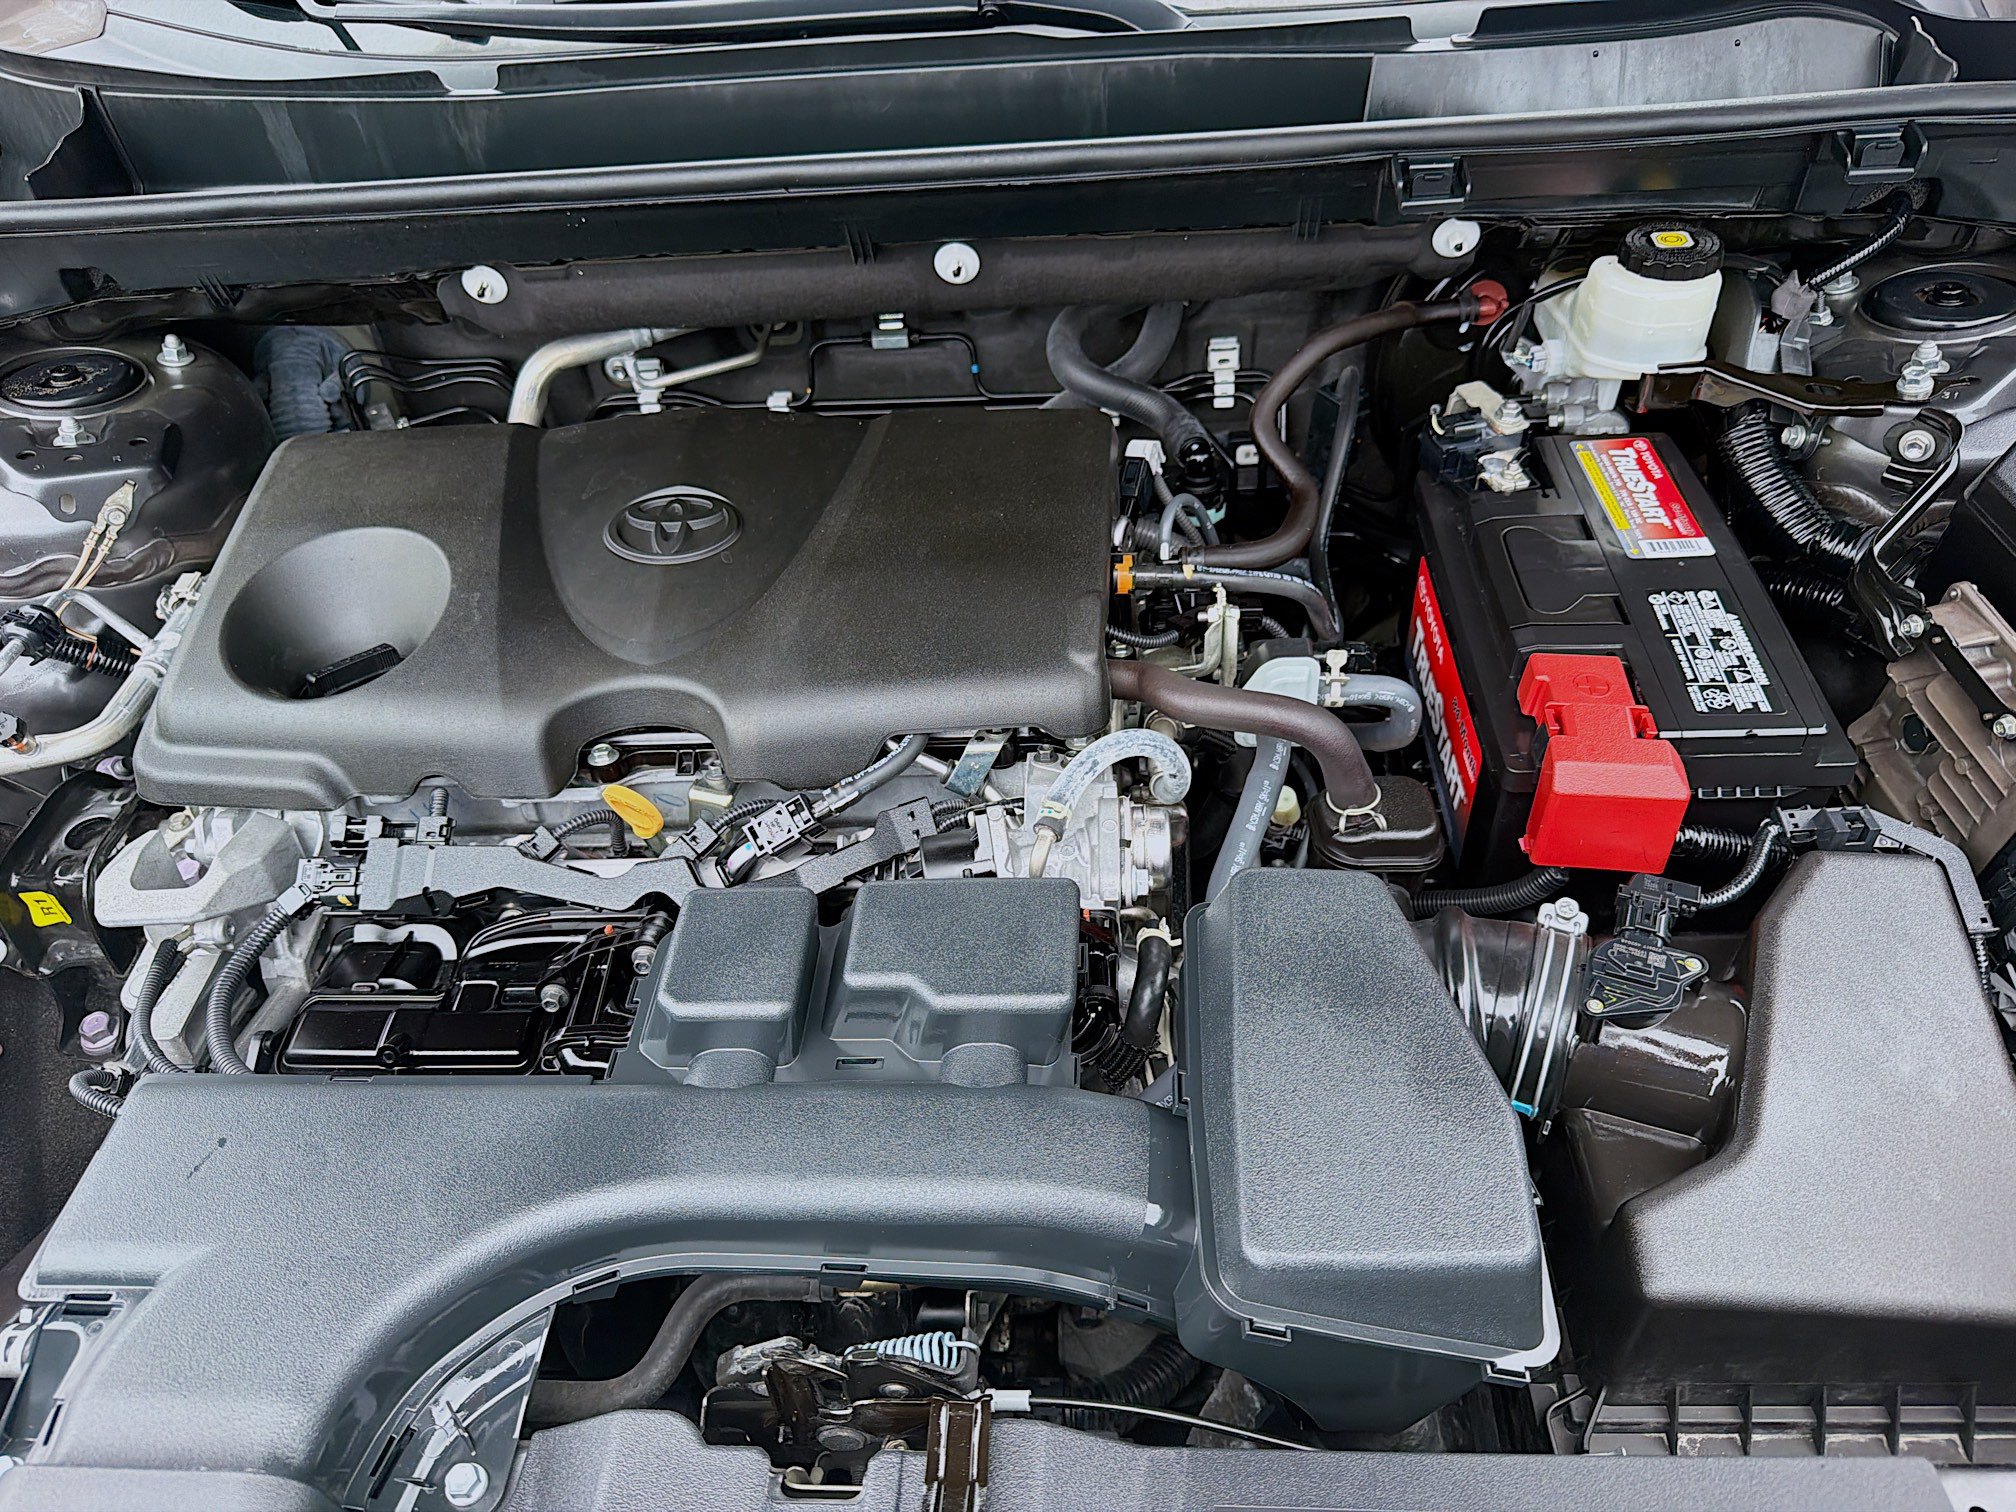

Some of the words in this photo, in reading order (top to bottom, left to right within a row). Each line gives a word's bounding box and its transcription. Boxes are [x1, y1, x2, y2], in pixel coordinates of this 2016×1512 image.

[1640, 451, 1664, 480] TOYOTA
[1424, 596, 1445, 666] TOYOTA
[33, 899, 58, 916] R1
